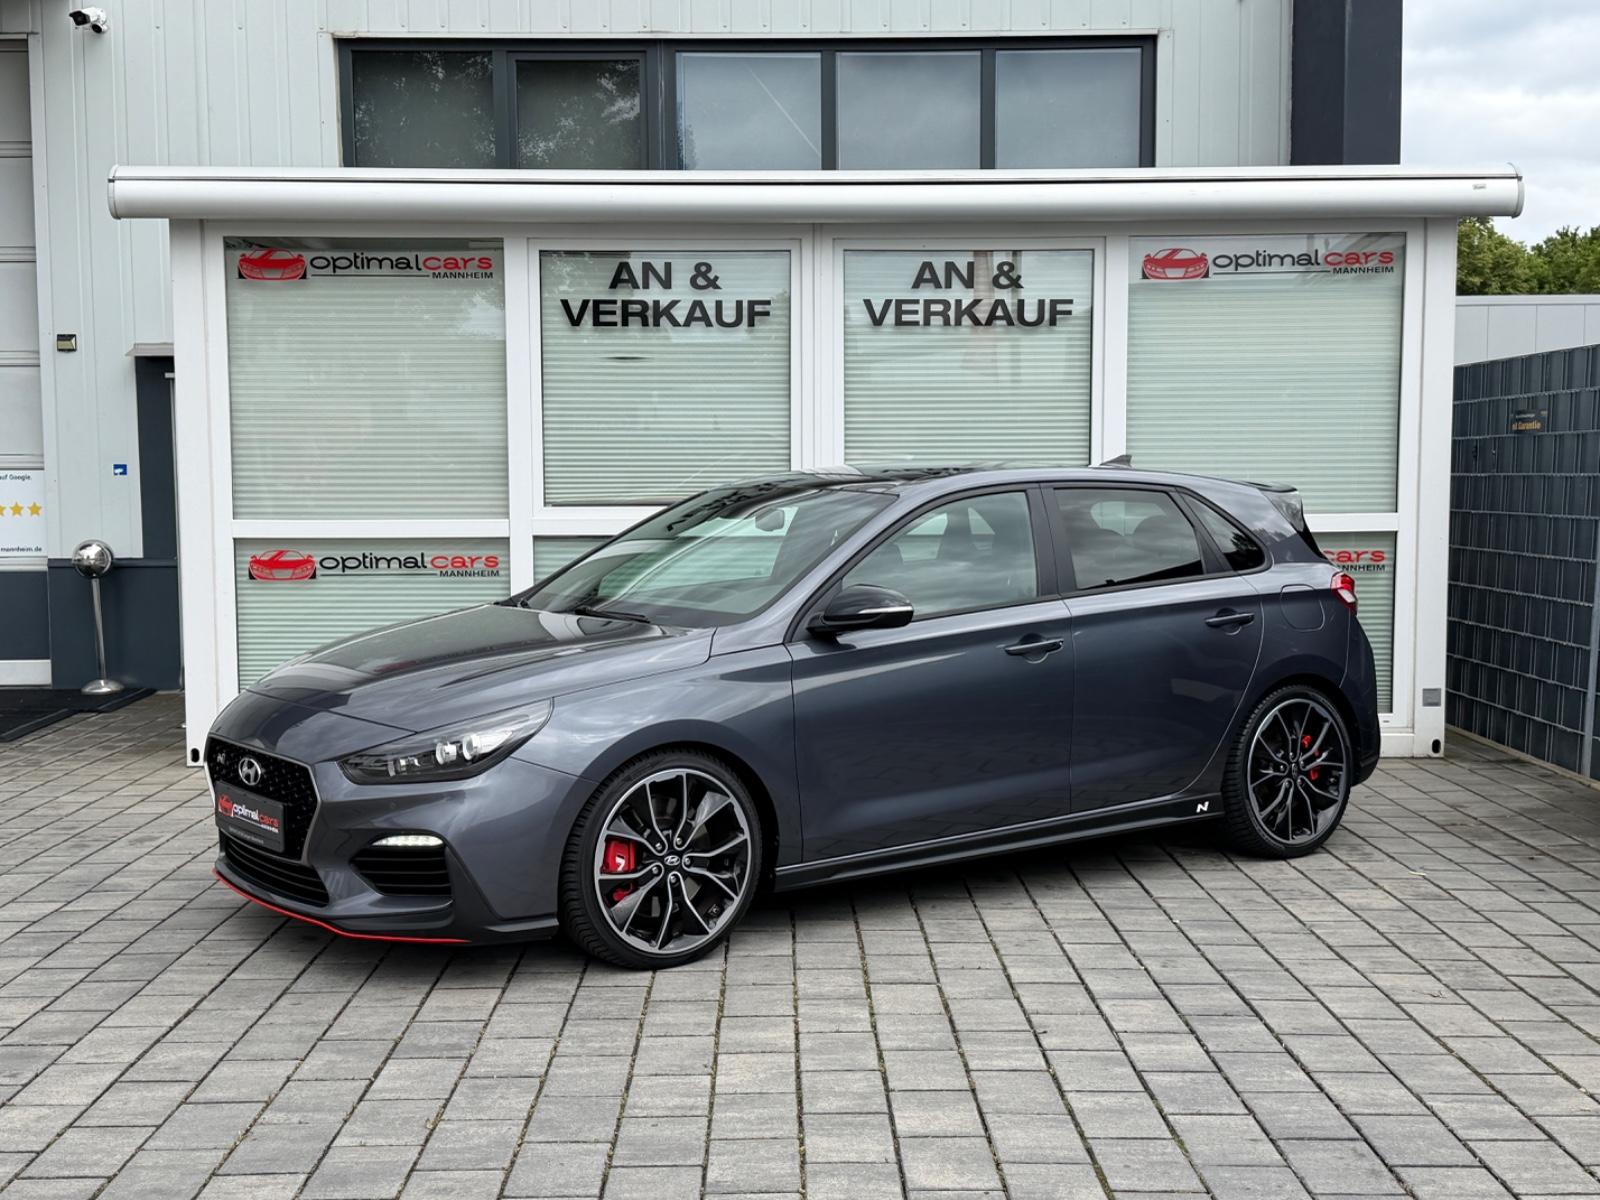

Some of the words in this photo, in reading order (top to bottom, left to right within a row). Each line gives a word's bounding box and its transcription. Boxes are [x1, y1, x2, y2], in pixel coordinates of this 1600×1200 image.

[608, 261, 672, 290] AN
[689, 261, 722, 290] &
[911, 260, 975, 289] AN
[992, 260, 1024, 290] &
[1332, 266, 1394, 275] MANNHEIM
[560, 299, 772, 328] VERKAUF
[863, 298, 1074, 327] VERKAUF
